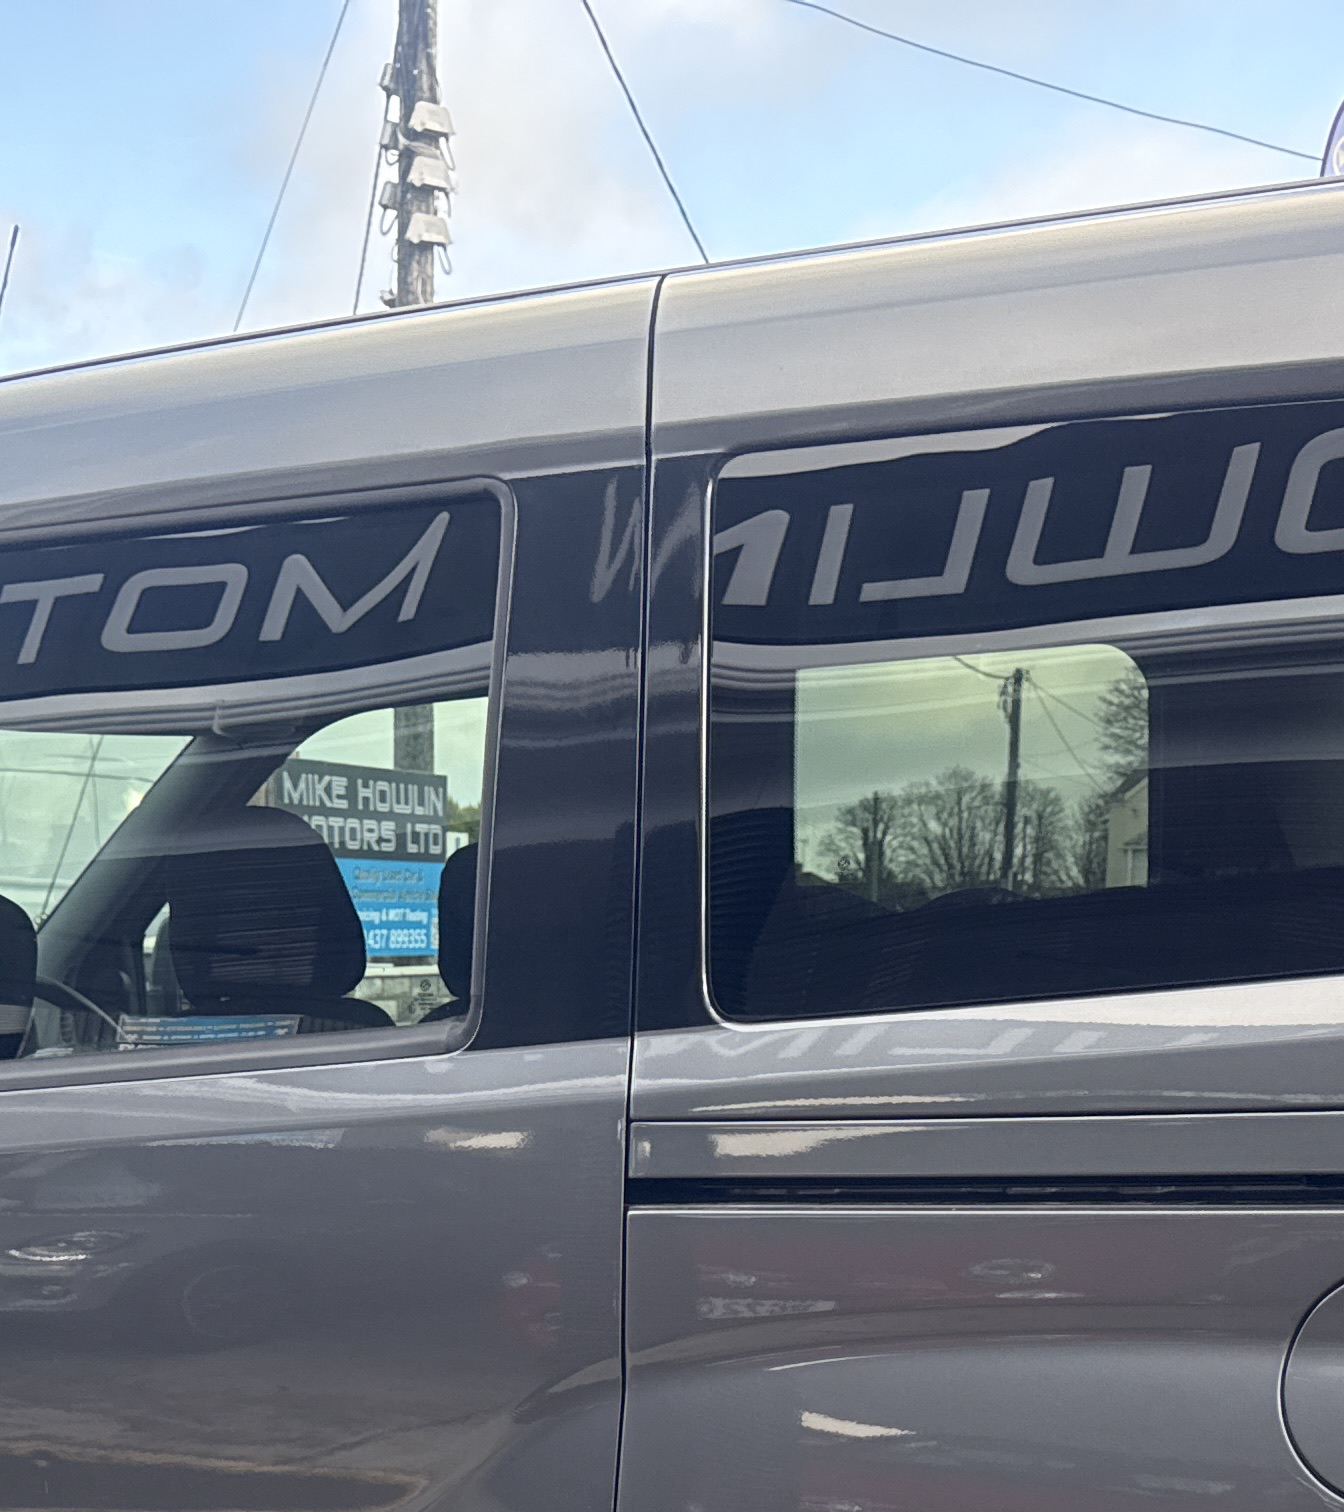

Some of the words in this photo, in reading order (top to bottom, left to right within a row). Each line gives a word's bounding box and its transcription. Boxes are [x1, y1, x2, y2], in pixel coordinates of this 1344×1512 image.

[282, 771, 349, 809] MIKE
[357, 778, 444, 817] HOWLIN
[304, 815, 396, 852] OTORS
[406, 822, 443, 855] LTD
